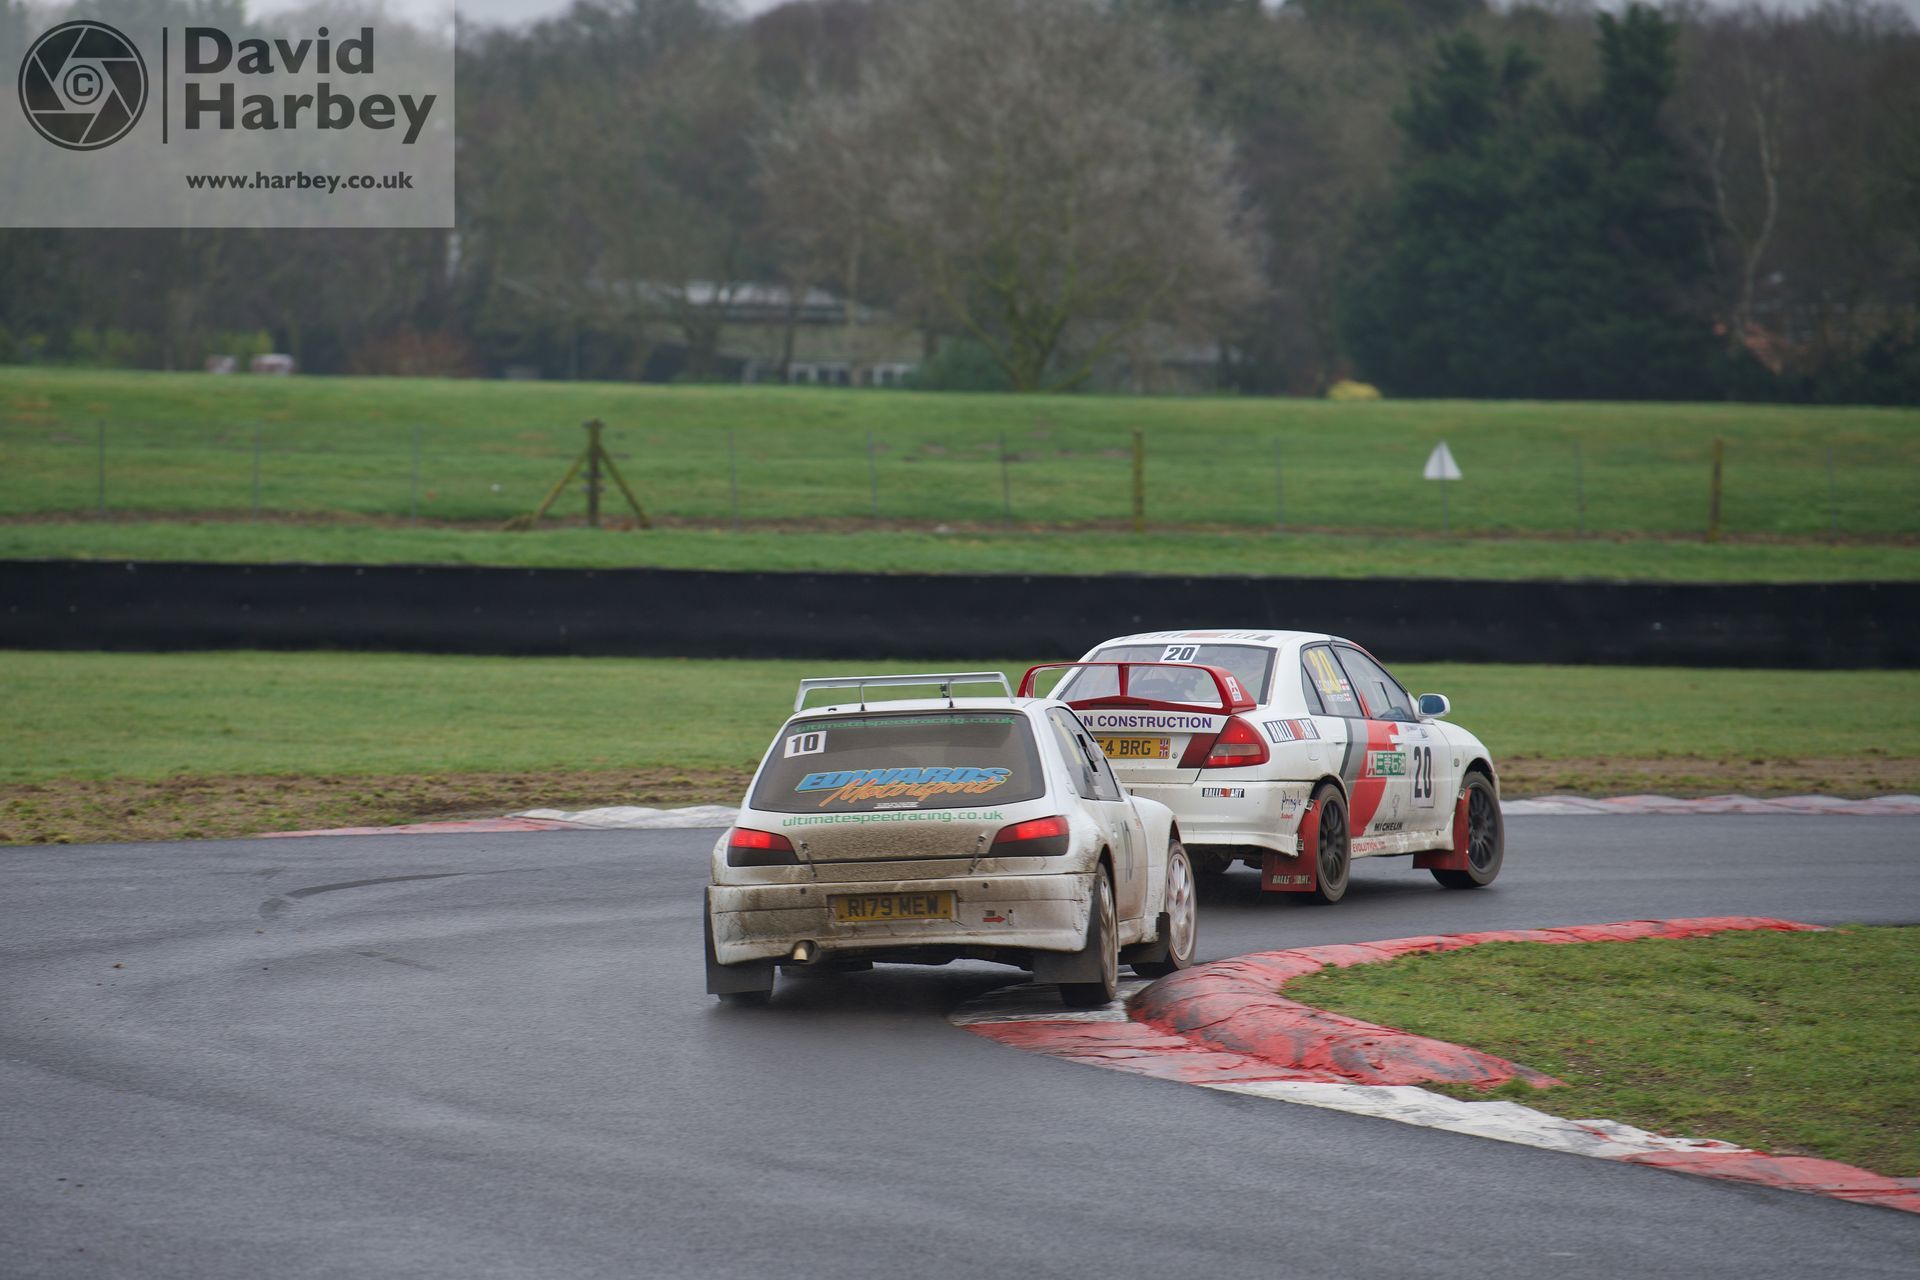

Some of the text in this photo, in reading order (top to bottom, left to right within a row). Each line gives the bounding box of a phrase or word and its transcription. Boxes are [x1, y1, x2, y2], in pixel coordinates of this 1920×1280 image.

[1164, 646, 1196, 661] 20
[1077, 715, 1212, 728] N CONSTRUCTION
[791, 733, 820, 754] 10
[1120, 740, 1152, 755] BRG
[795, 767, 1013, 793] EDWARDS
[1414, 746, 1432, 798] 20
[782, 810, 1004, 828] ultimatespeedracing.co.uk
[1374, 822, 1402, 831] MICHELIN
[847, 897, 893, 917] R179
